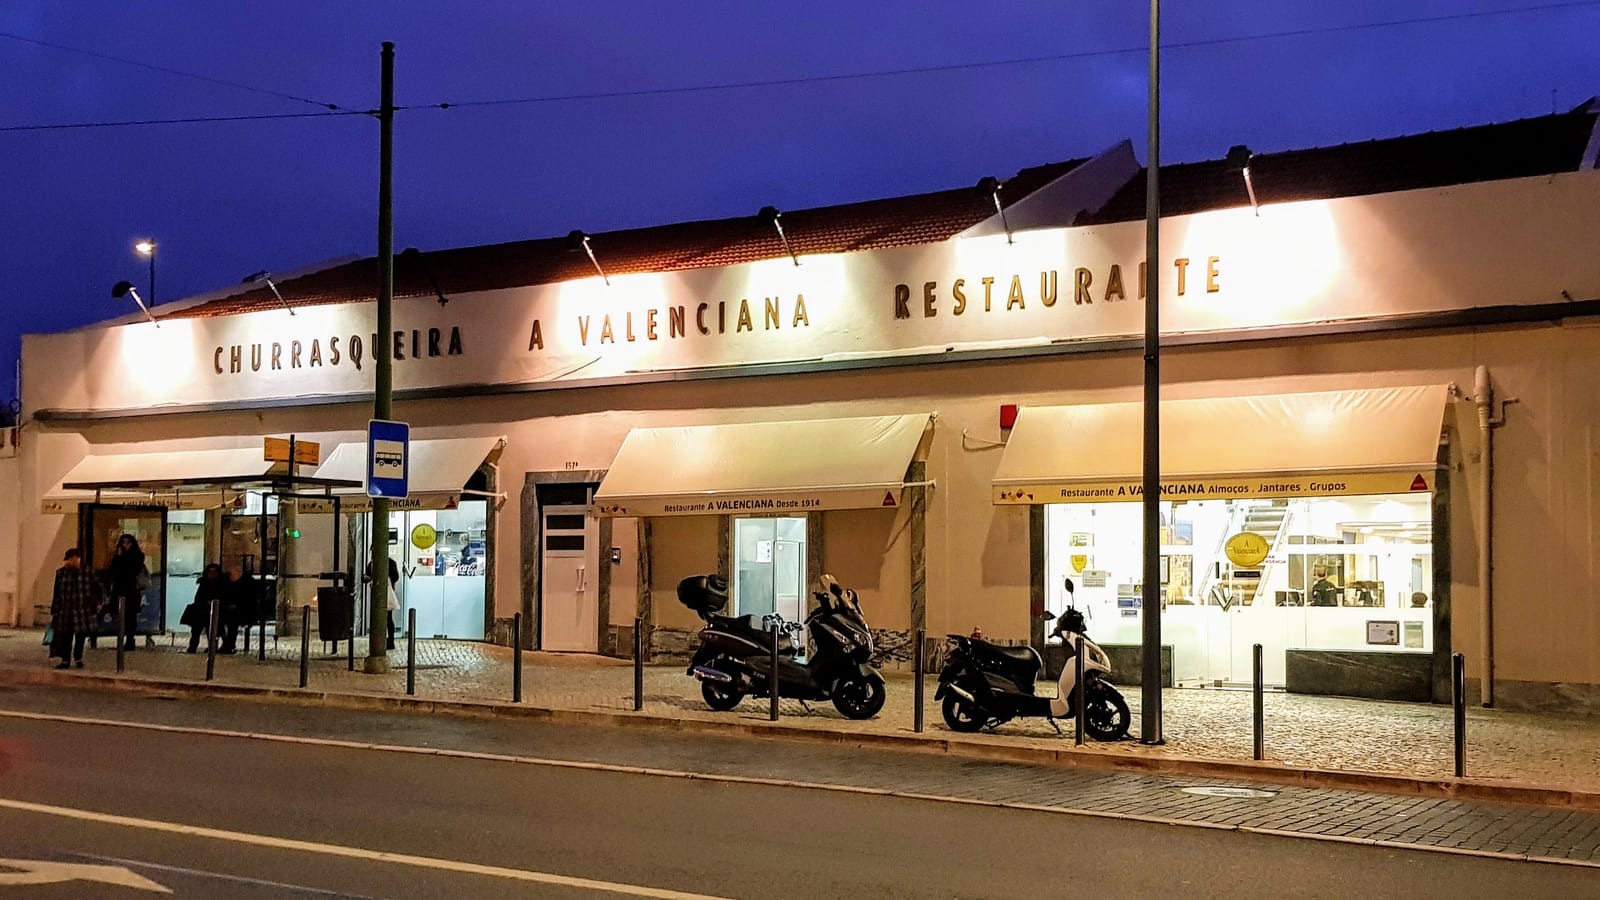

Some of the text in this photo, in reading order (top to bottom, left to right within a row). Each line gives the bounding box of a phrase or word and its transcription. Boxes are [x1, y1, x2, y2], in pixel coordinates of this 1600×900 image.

[528, 319, 544, 352] A
[578, 294, 809, 347] VALENCIANA
[1060, 488, 1114, 497] Restaurante
[1117, 486, 1126, 496] A
[1129, 484, 1205, 496] VANCIANA
[1208, 484, 1249, 495] Almoços
[1257, 482, 1301, 493] Jantares
[1309, 482, 1346, 492] Grupos
[664, 499, 820, 513] Restaurante A VALENCIANA Desde 1914
